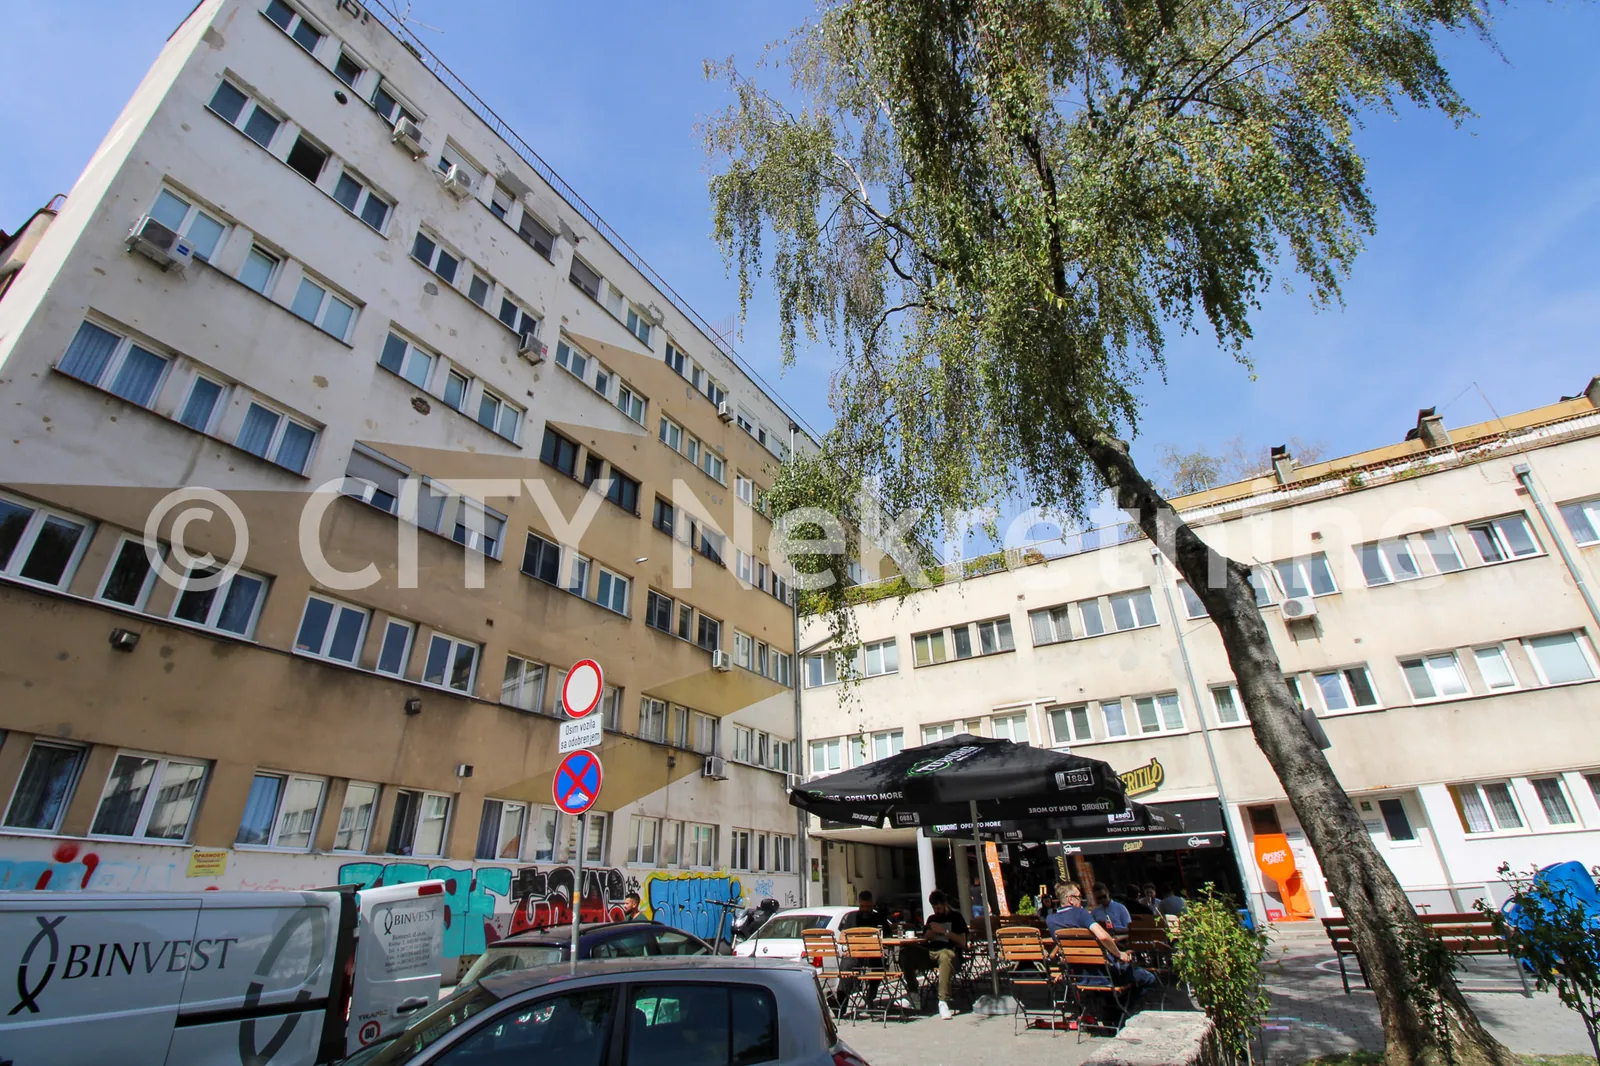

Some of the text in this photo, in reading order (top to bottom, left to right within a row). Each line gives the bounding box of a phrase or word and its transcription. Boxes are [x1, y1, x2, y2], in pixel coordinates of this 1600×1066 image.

[565, 719, 596, 735] Osim vozila
[561, 732, 600, 749] sa odobrenjem
[1066, 773, 1089, 783] 1880
[844, 794, 866, 802] OPEN
[866, 793, 878, 801] TO
[879, 791, 903, 800] MORE
[936, 823, 958, 831] TUBORG
[394, 909, 436, 925] BINVEST
[61, 938, 238, 980] BINVEST
[364, 1027, 375, 1039] 80
